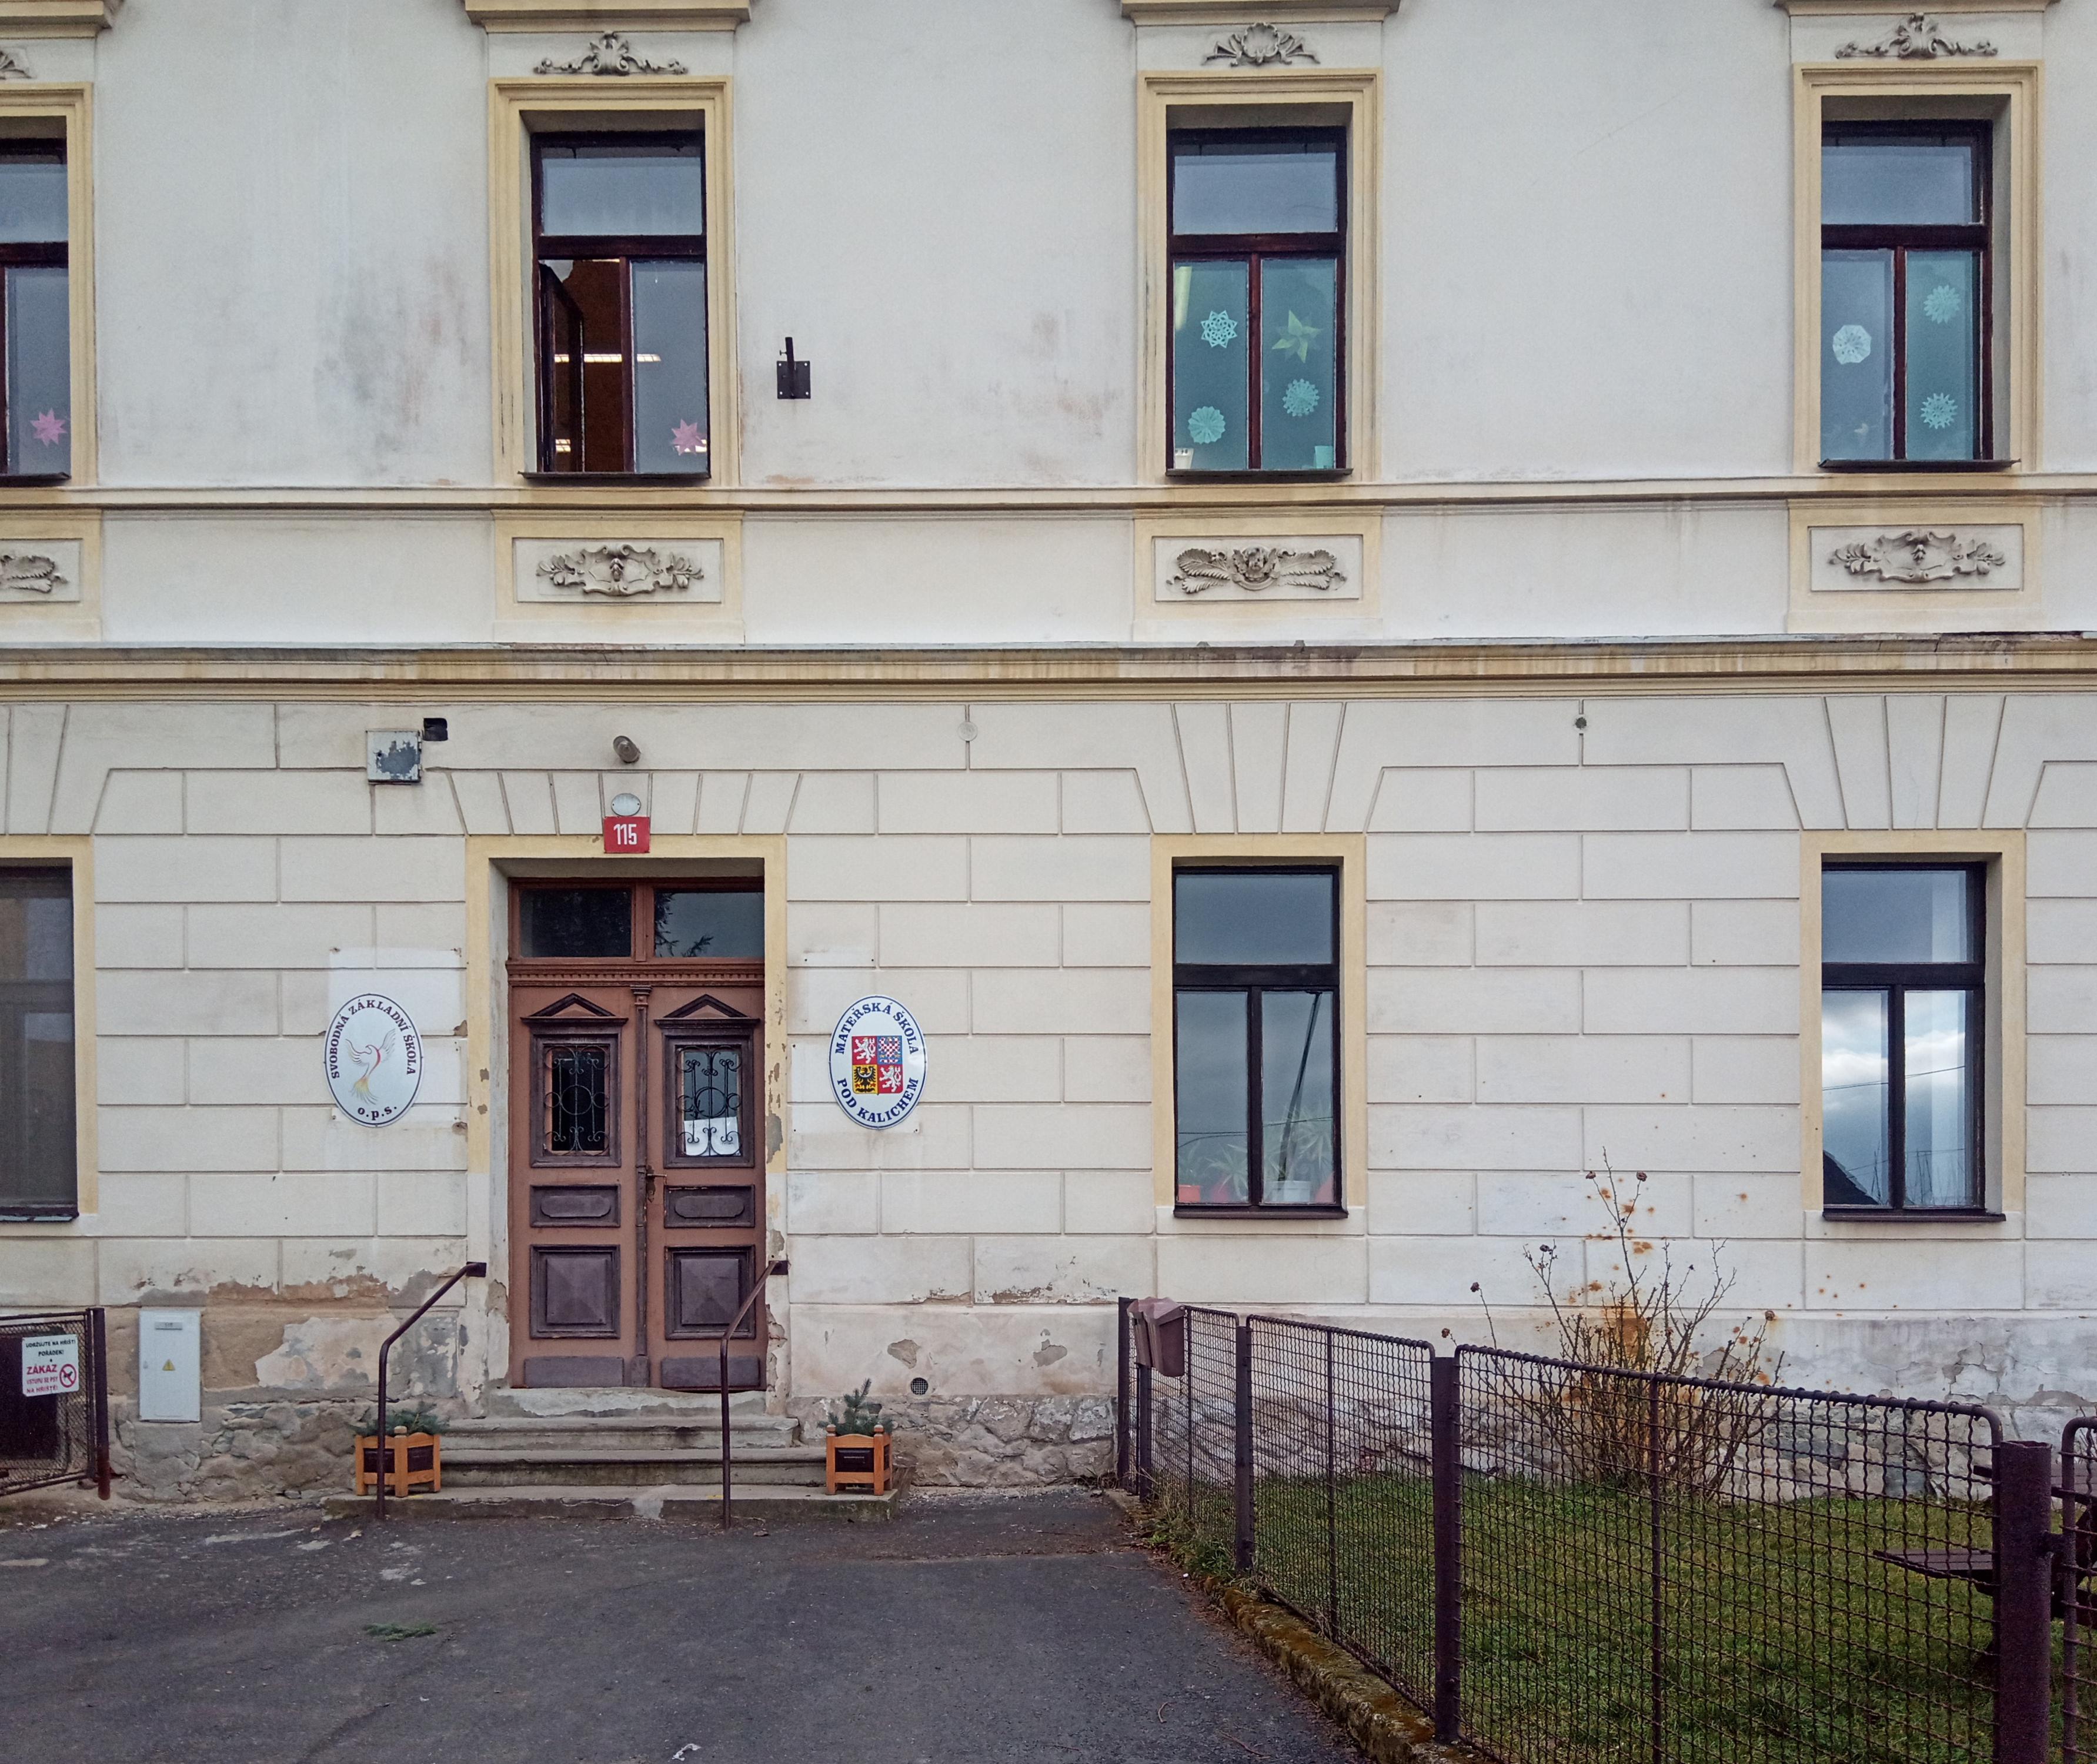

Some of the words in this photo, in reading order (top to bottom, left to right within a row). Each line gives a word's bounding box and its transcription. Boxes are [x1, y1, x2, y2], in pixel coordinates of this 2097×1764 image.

[613, 824, 637, 844] 115
[329, 1014, 349, 1078] SVOBODNÁ
[348, 999, 412, 1031] ZÁKLADNÍ
[403, 1034, 416, 1075] ŠKOLA
[835, 1002, 893, 1054] MATEŘSKÁ
[893, 1011, 919, 1054] ŠKOLA
[357, 1105, 397, 1120] o.p.s.
[837, 1078, 857, 1108] POD
[857, 1077, 919, 1122] KALICHEM
[26, 1364, 57, 1375] ZÁKAZ
